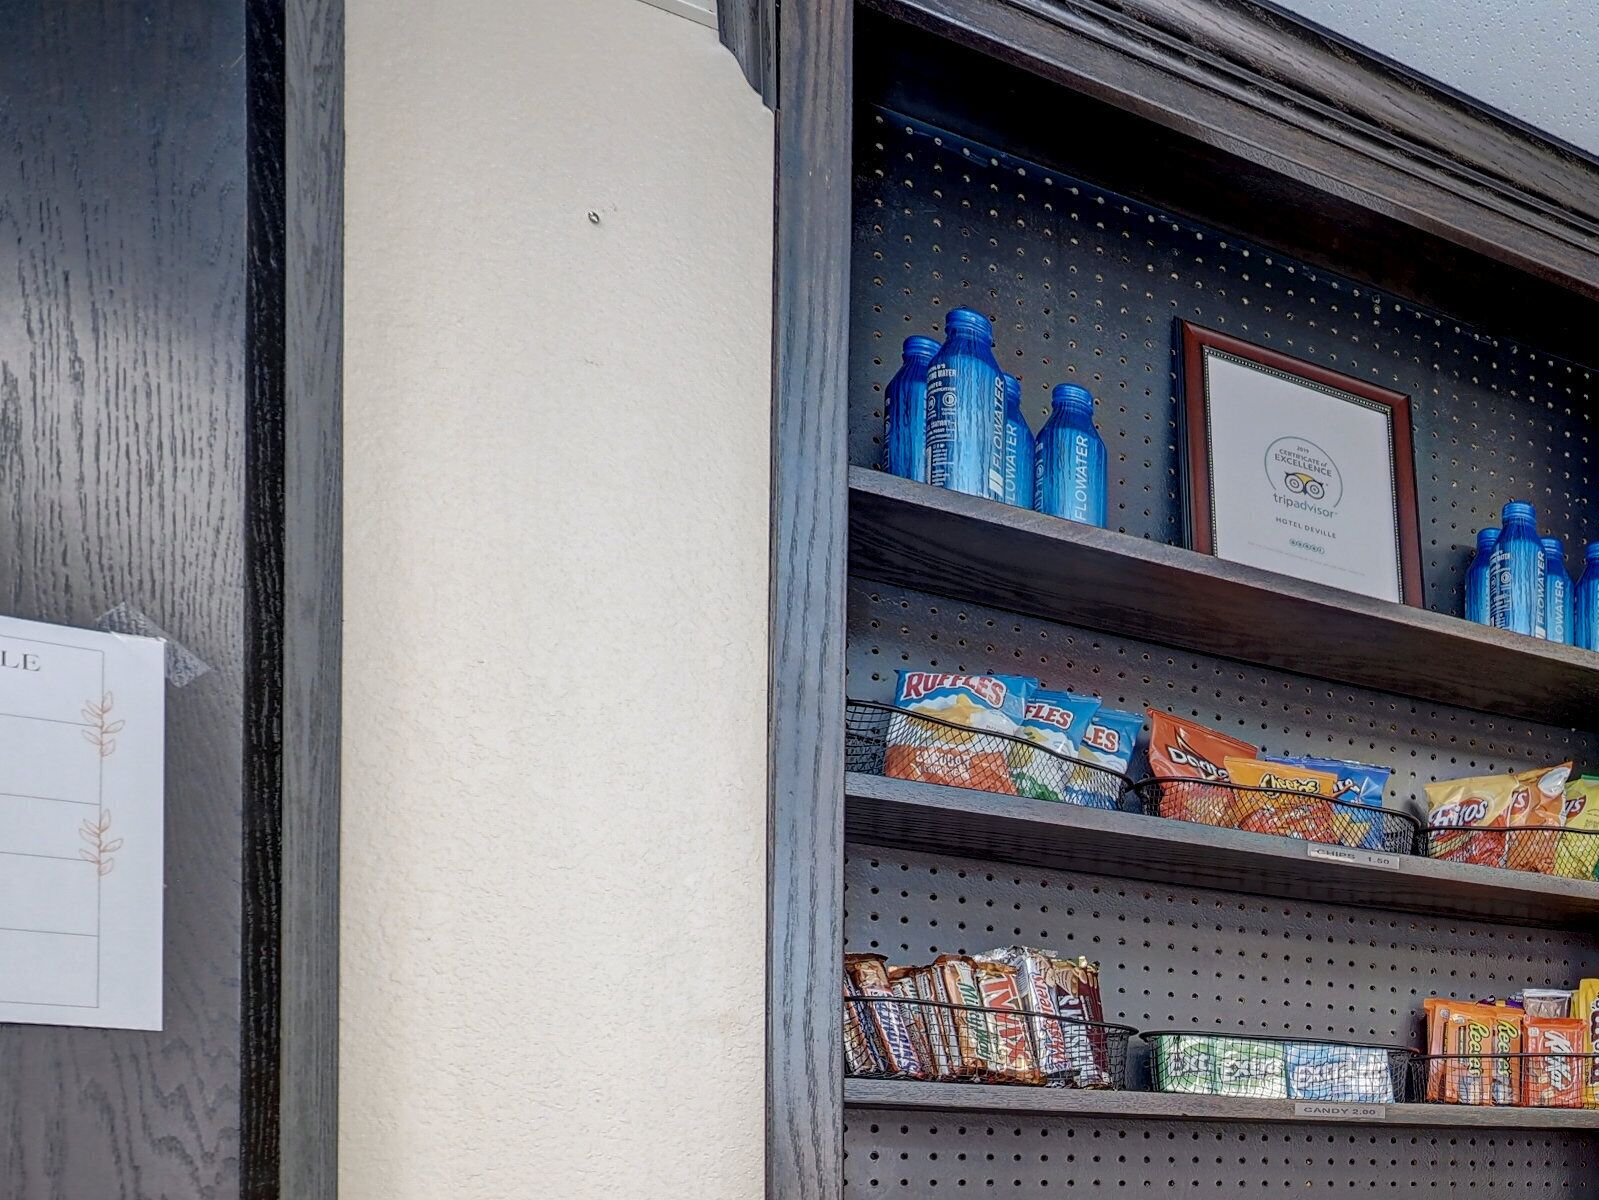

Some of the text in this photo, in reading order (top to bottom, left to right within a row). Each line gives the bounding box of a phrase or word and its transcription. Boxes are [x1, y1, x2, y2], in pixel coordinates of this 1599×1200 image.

[992, 376, 1006, 467] FLOWATER
[1274, 453, 1332, 477] EXCELLENCE
[1279, 448, 1320, 466] CERTIFICATE
[1074, 434, 1089, 521] FLOWATER
[1273, 493, 1334, 518] tripadvisor
[1275, 517, 1337, 539] HOTEL DEVILLE
[1537, 551, 1546, 624] FLOWATER
[902, 671, 1006, 709] RUFFLES
[1316, 847, 1356, 860] CHIPS
[984, 974, 1030, 1064] TWIX
[1303, 1107, 1376, 1116] CANDY 2.00
